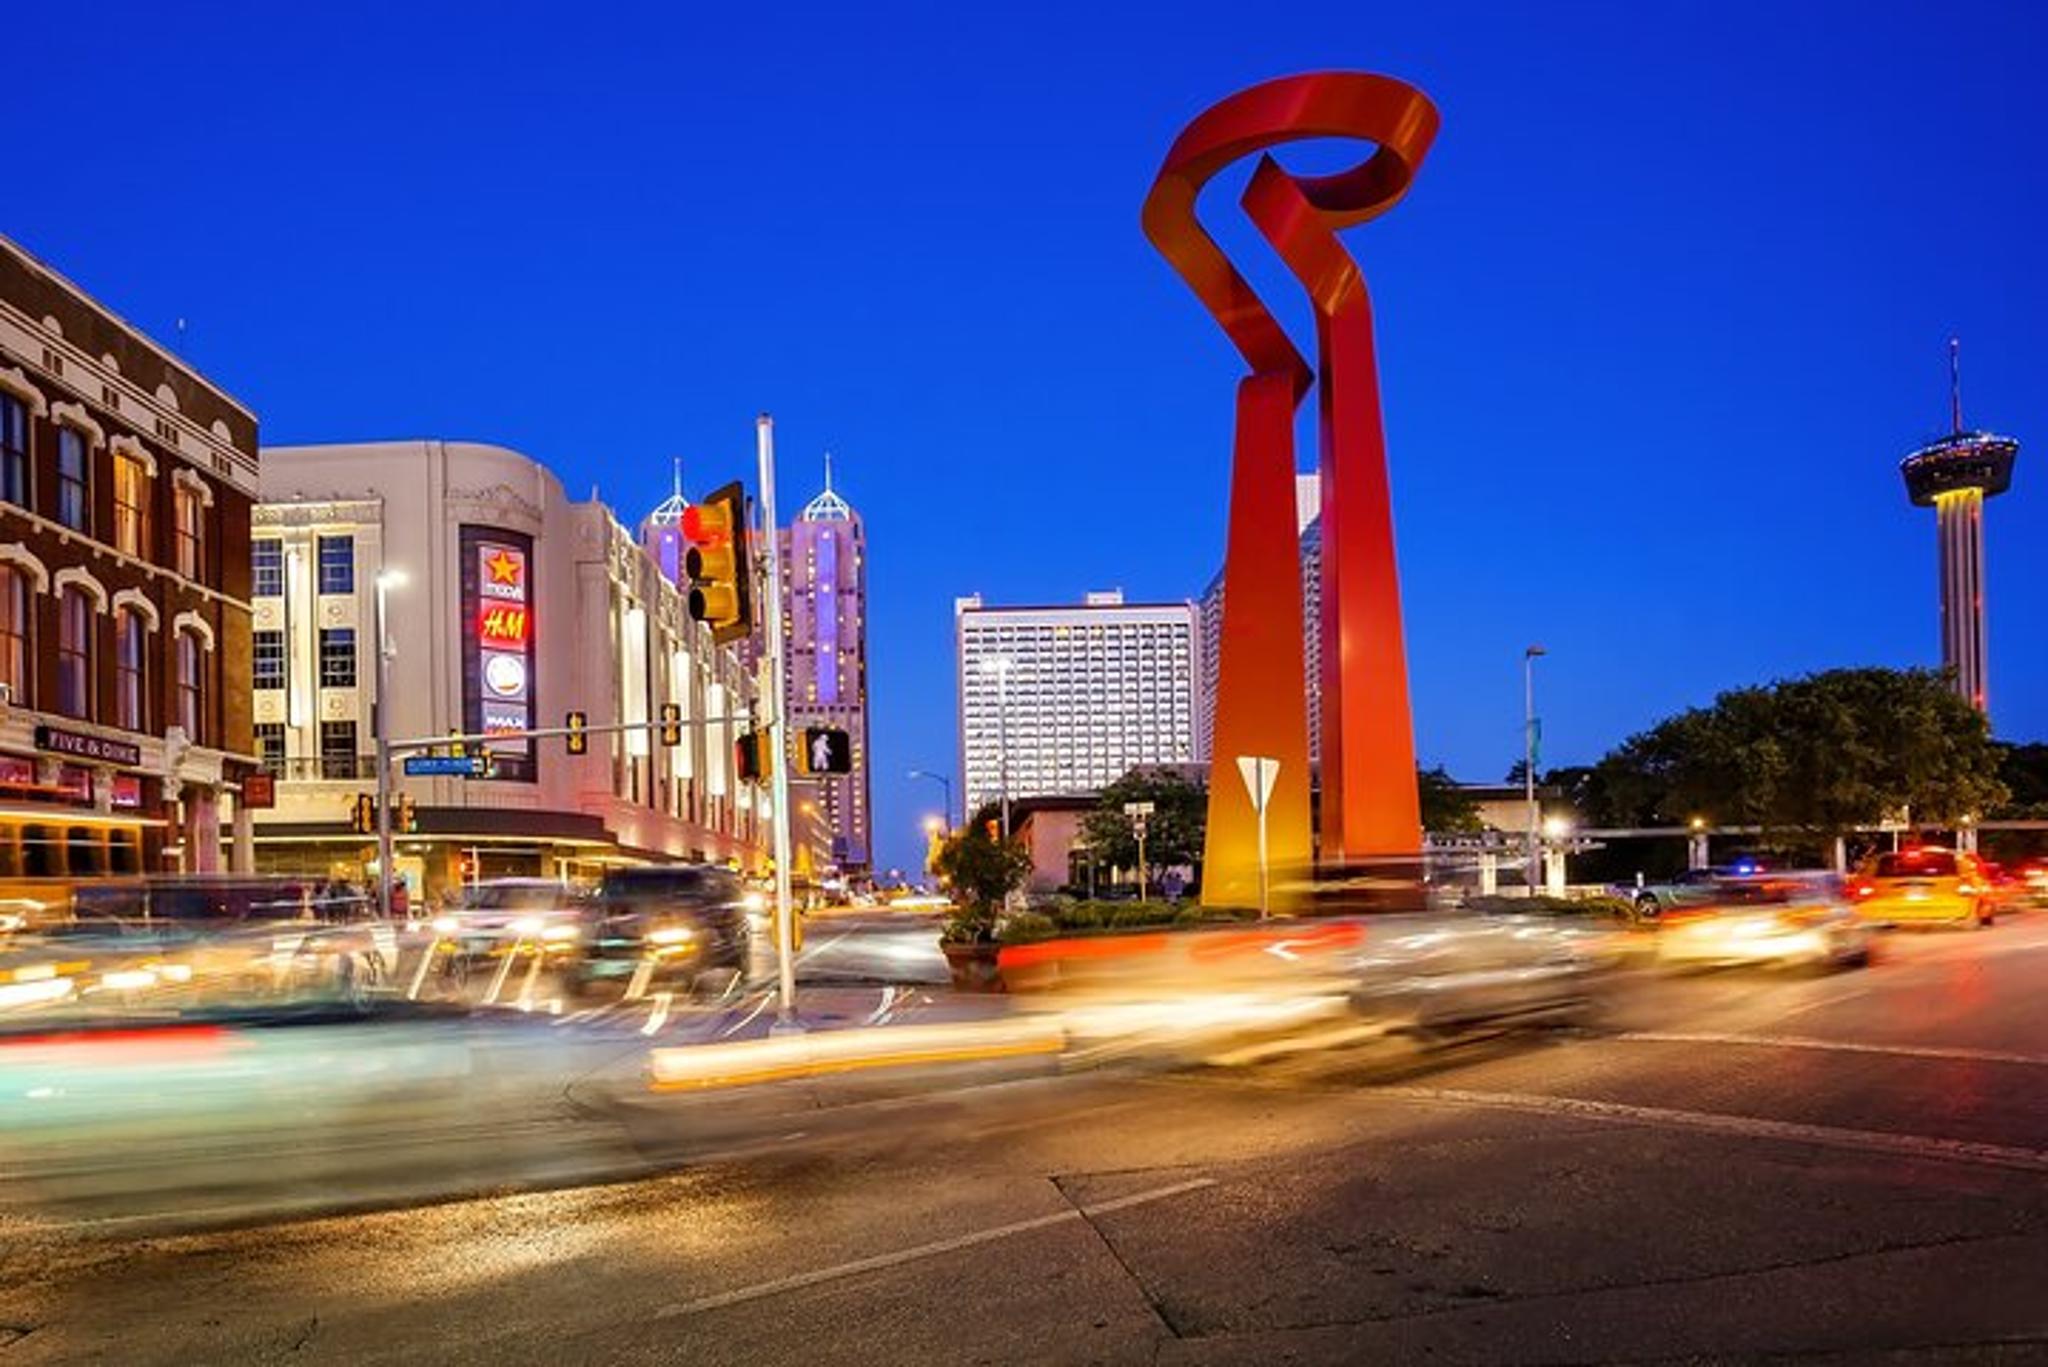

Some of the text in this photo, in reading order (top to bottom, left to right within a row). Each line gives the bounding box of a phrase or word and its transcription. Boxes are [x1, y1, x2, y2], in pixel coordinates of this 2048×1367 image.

[483, 608, 524, 639] H&M
[49, 731, 84, 753] FIVE
[87, 740, 99, 756] &
